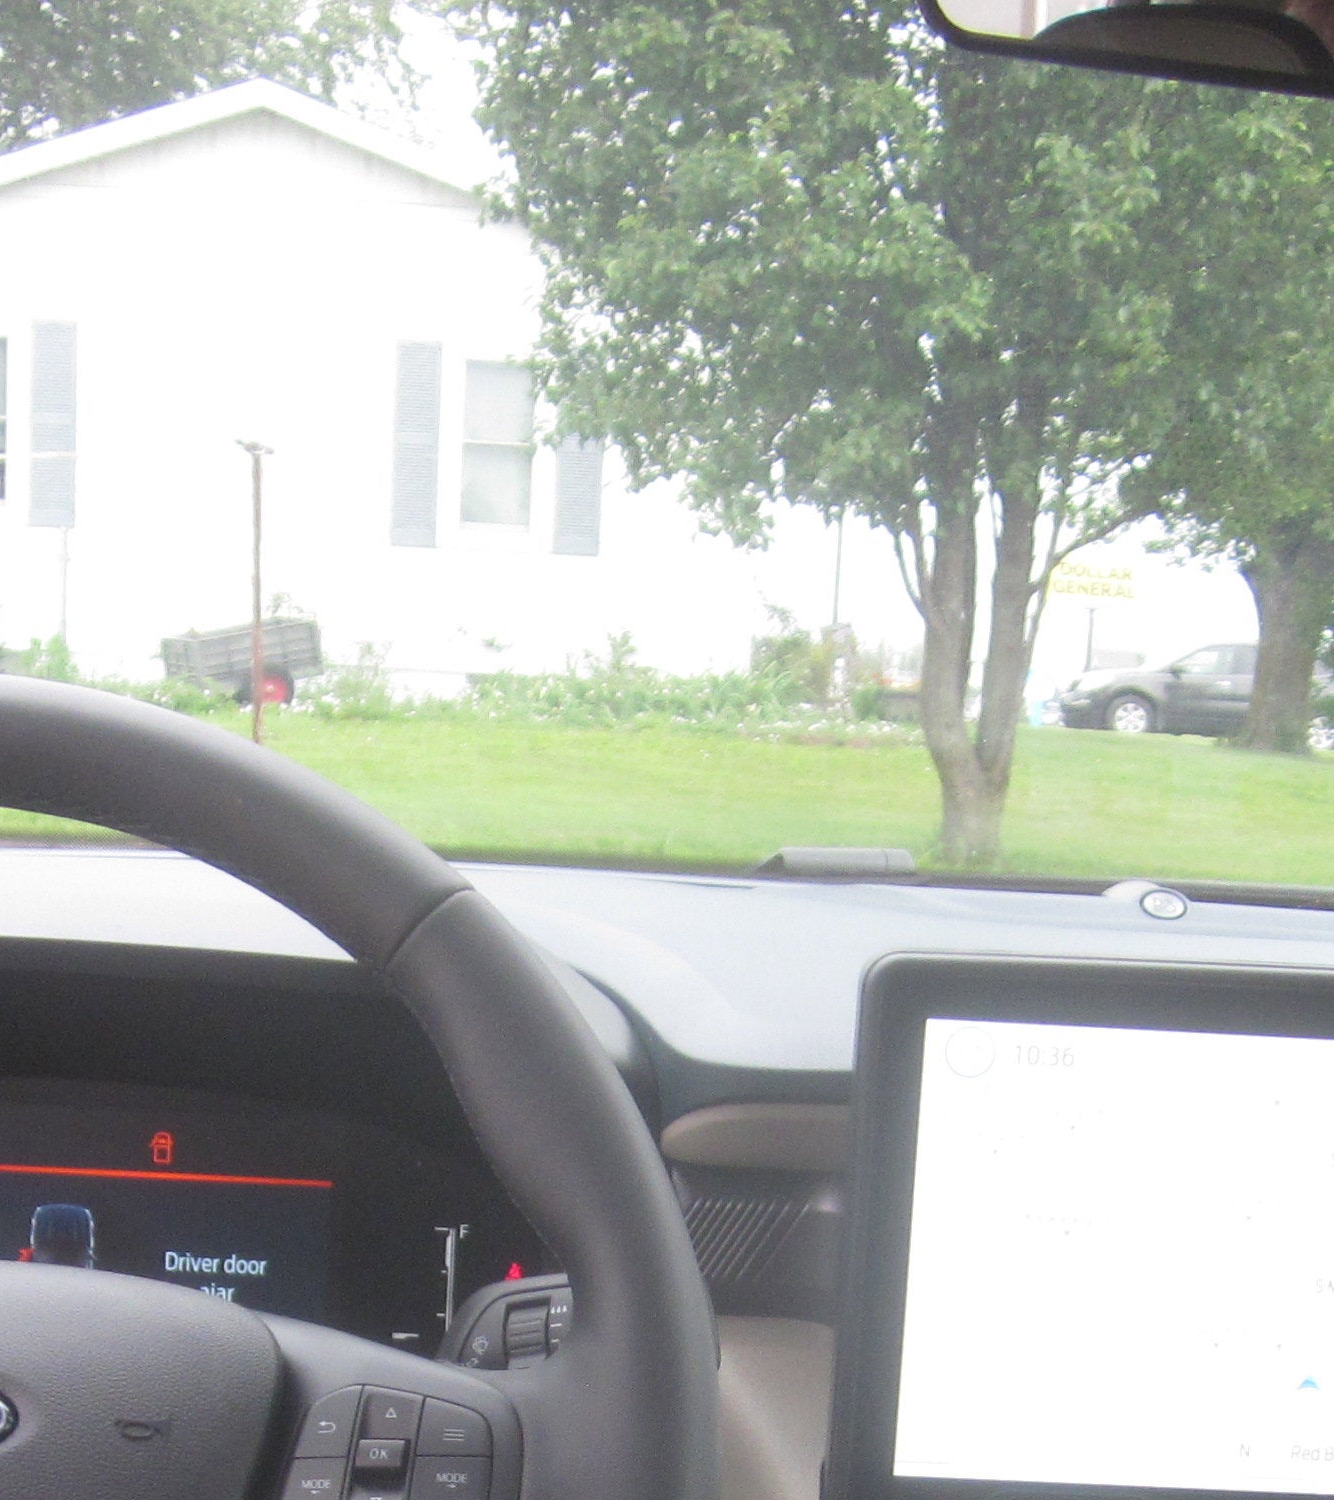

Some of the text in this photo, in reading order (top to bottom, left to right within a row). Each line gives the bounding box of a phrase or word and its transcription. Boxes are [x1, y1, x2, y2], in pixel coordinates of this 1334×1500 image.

[1060, 561, 1132, 580] DOLLAR
[1052, 580, 1135, 599] GENERAL
[1014, 1043, 1075, 1069] 10:36
[459, 1223, 471, 1239] F
[164, 1251, 267, 1277] Driver door
[369, 1448, 388, 1459] OK
[1239, 1442, 1251, 1458] N
[1290, 1444, 1320, 1462] Red
[301, 1479, 331, 1489] MODE
[436, 1472, 468, 1484] MODE
